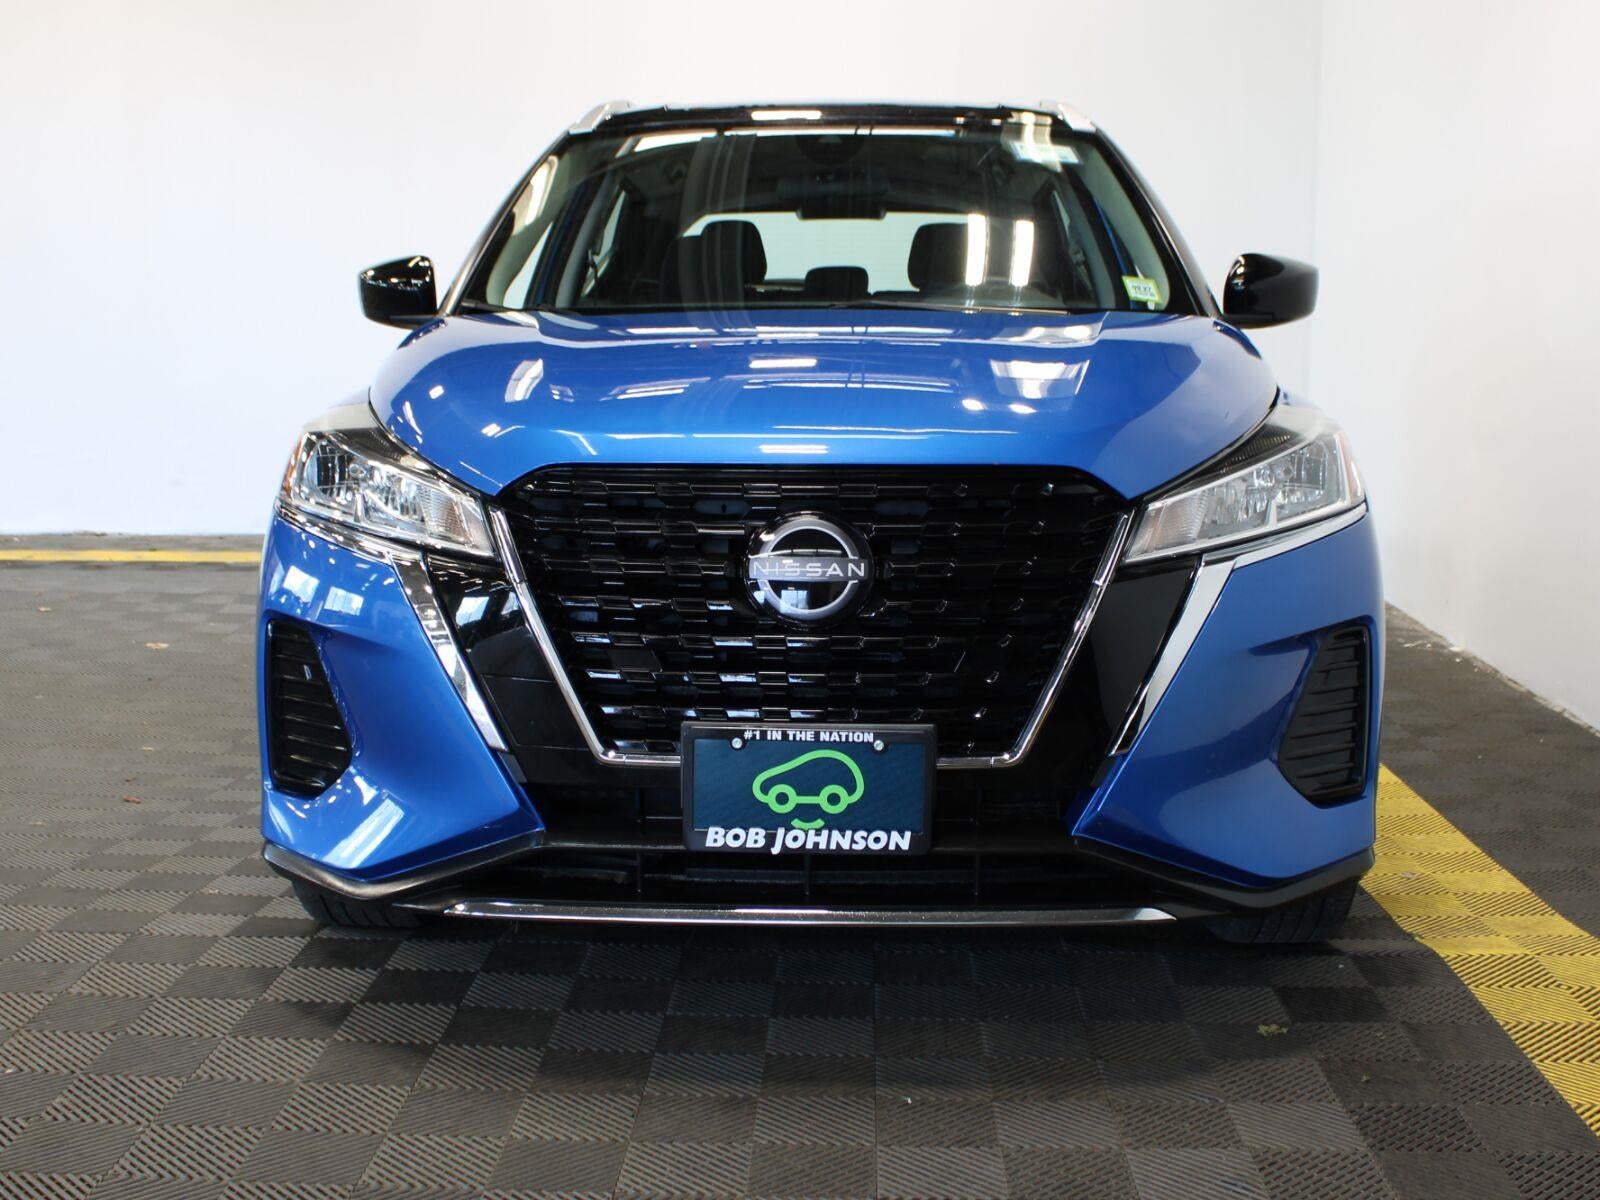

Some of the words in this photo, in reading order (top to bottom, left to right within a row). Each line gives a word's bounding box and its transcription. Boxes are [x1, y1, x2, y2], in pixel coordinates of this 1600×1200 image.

[753, 561, 865, 577] NISSAN
[743, 730, 761, 740] #1
[767, 731, 782, 741] IN
[786, 731, 815, 742] THE
[819, 732, 874, 743] NATION
[705, 826, 767, 849] BOB
[770, 826, 911, 855] JOHNSON
